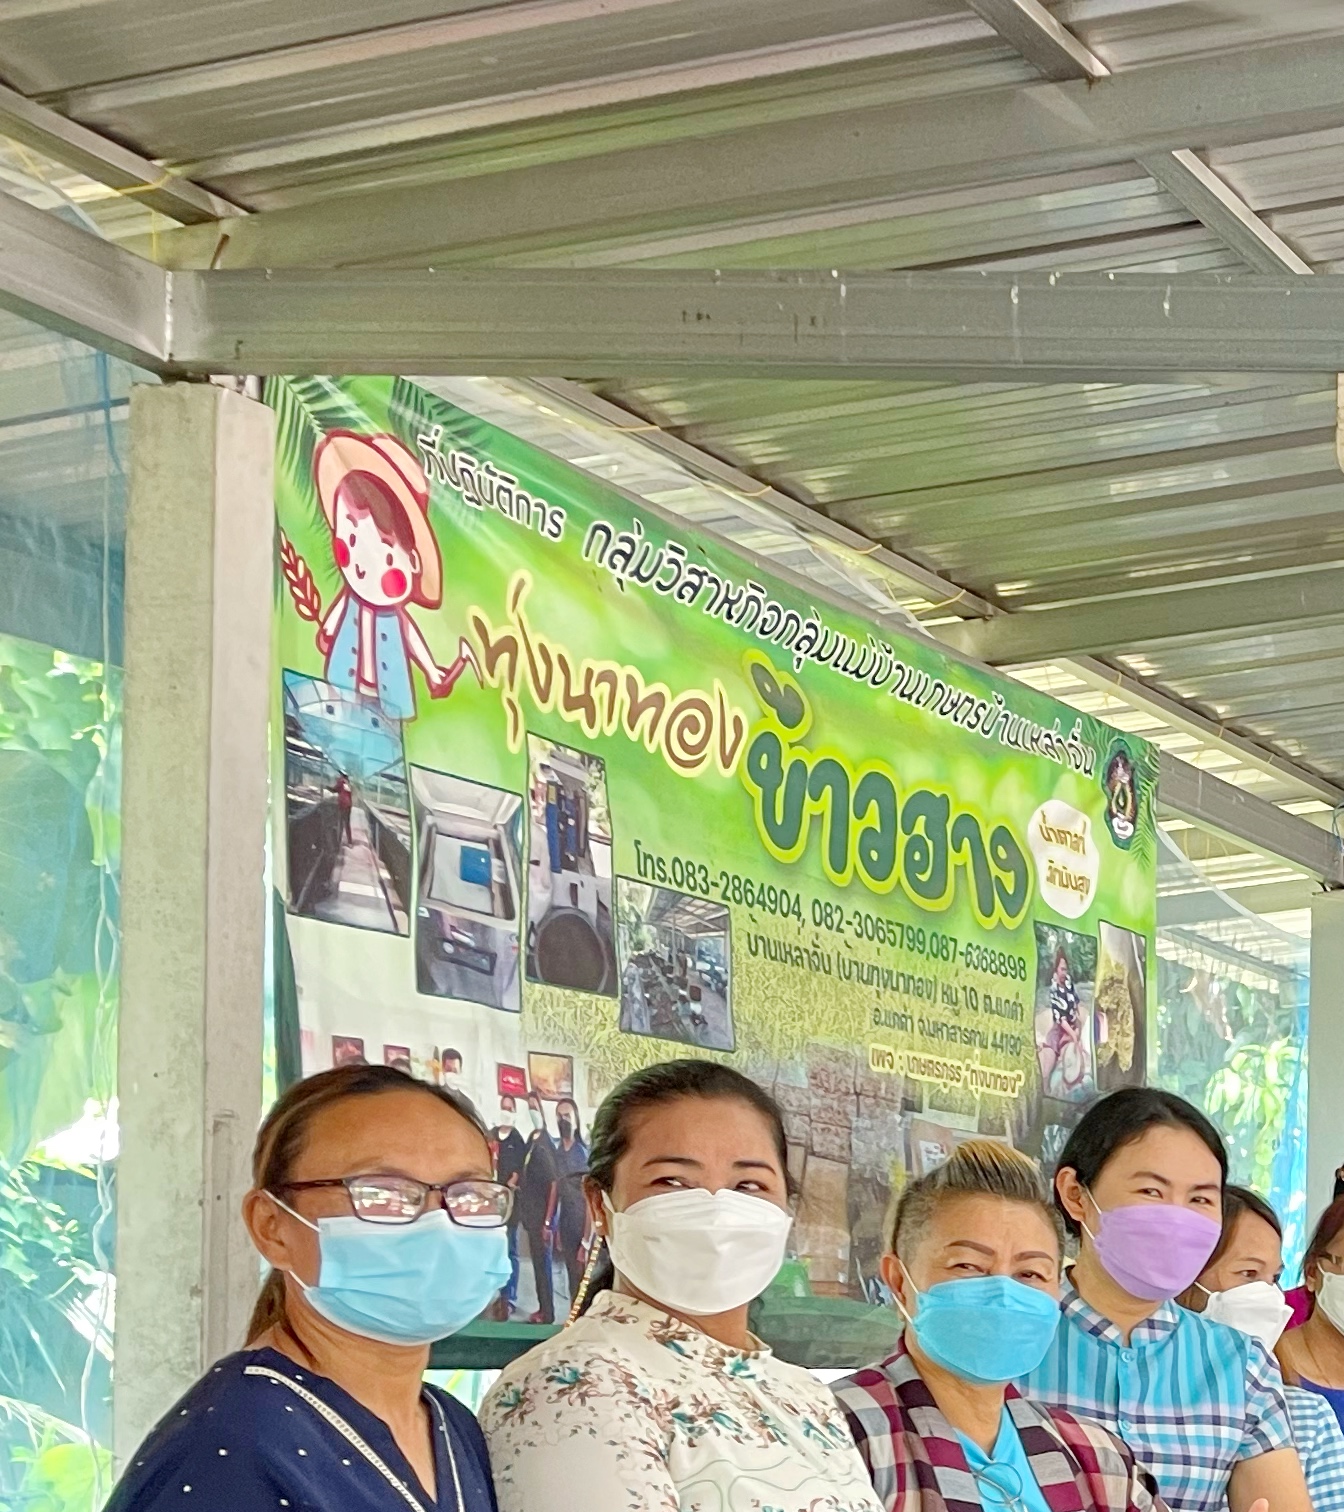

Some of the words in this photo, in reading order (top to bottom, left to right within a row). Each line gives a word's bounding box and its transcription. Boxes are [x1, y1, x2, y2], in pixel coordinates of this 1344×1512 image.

[470, 575, 746, 772] ทุ่งนาทอง
[746, 660, 1030, 920] ข้าวฮาง
[961, 985, 979, 1011] 10
